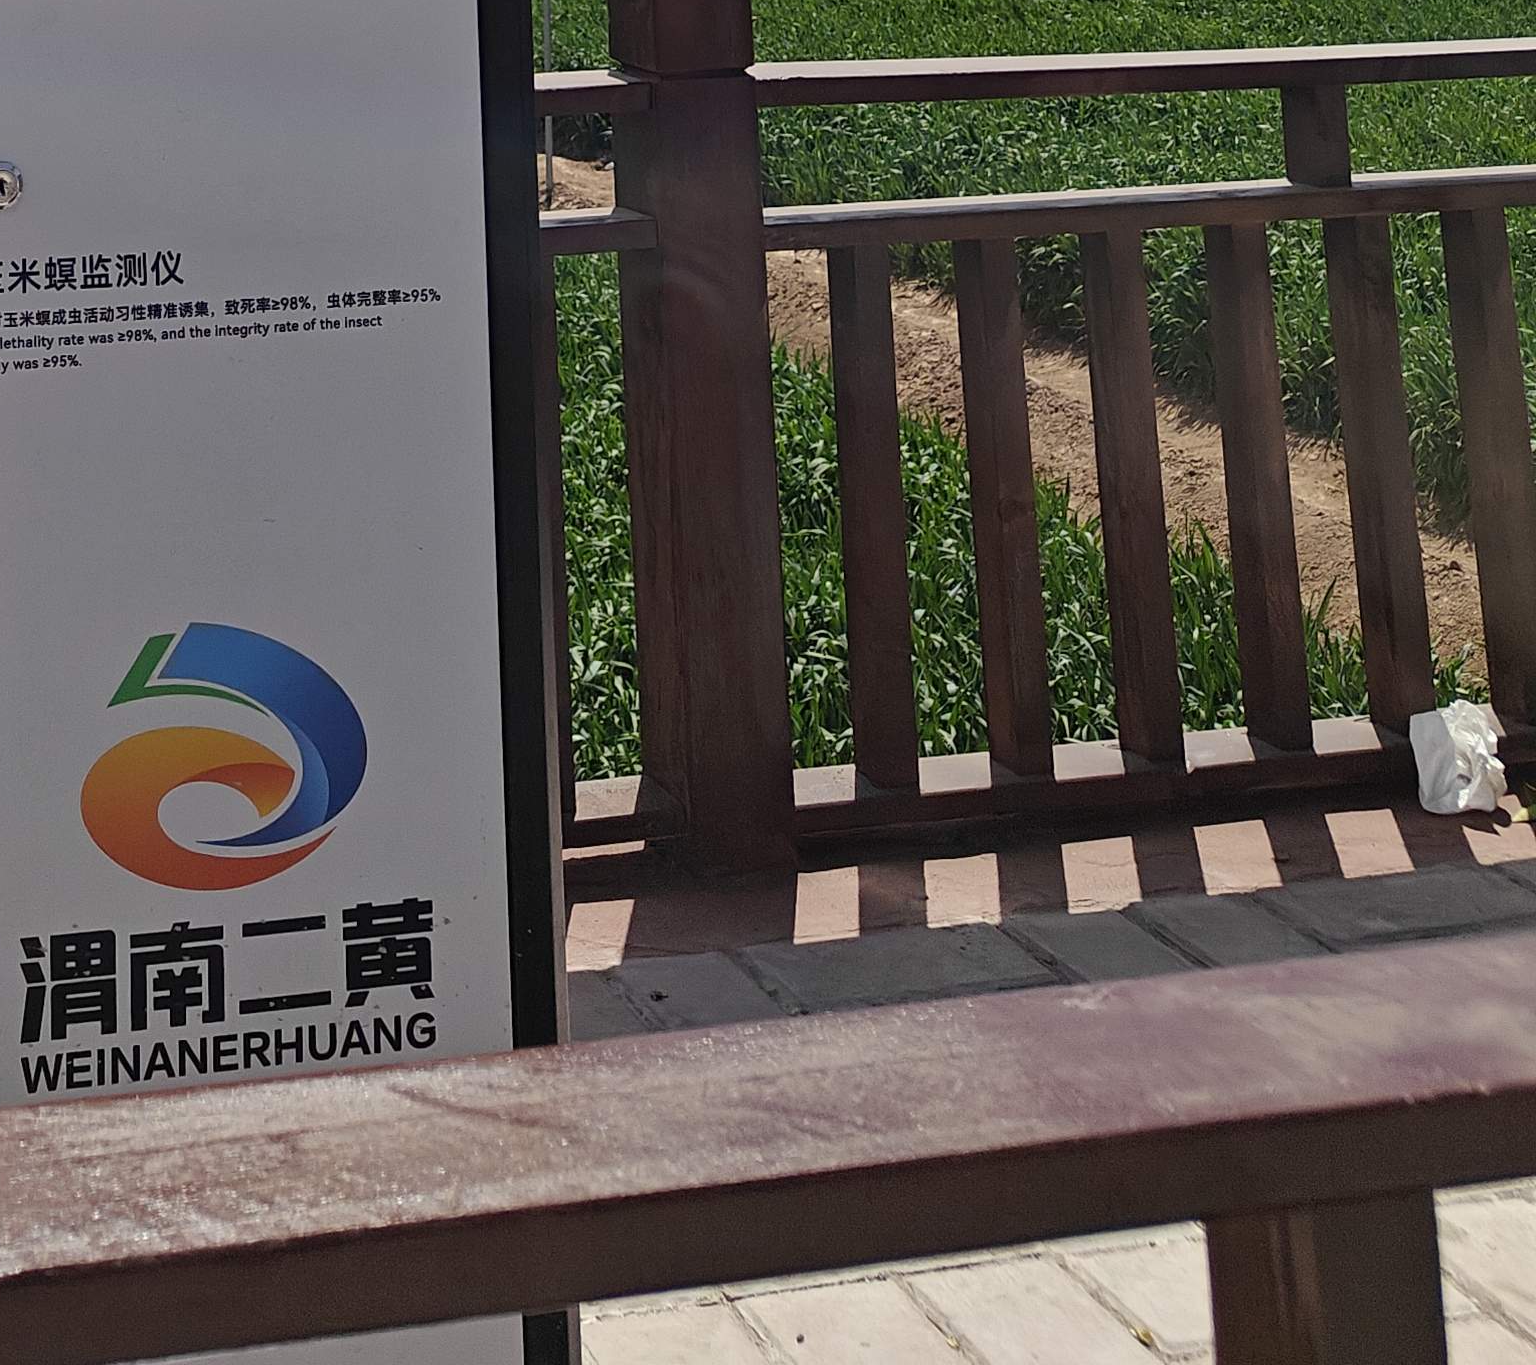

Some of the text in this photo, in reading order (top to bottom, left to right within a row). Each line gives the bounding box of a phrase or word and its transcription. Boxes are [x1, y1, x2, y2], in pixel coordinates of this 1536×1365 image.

[0, 335, 54, 350] lethality
[58, 334, 84, 346] rate
[88, 332, 113, 344] was
[161, 326, 185, 340] and
[189, 325, 211, 338] the
[215, 322, 270, 338] integrity
[274, 321, 299, 333] rate
[303, 318, 316, 331] of
[320, 318, 340, 330] the
[344, 316, 382, 328] insect
[13, 359, 38, 370] was
[20, 897, 436, 1044] 渭南二黄
[20, 1012, 437, 1094] WEINANERHUANG
